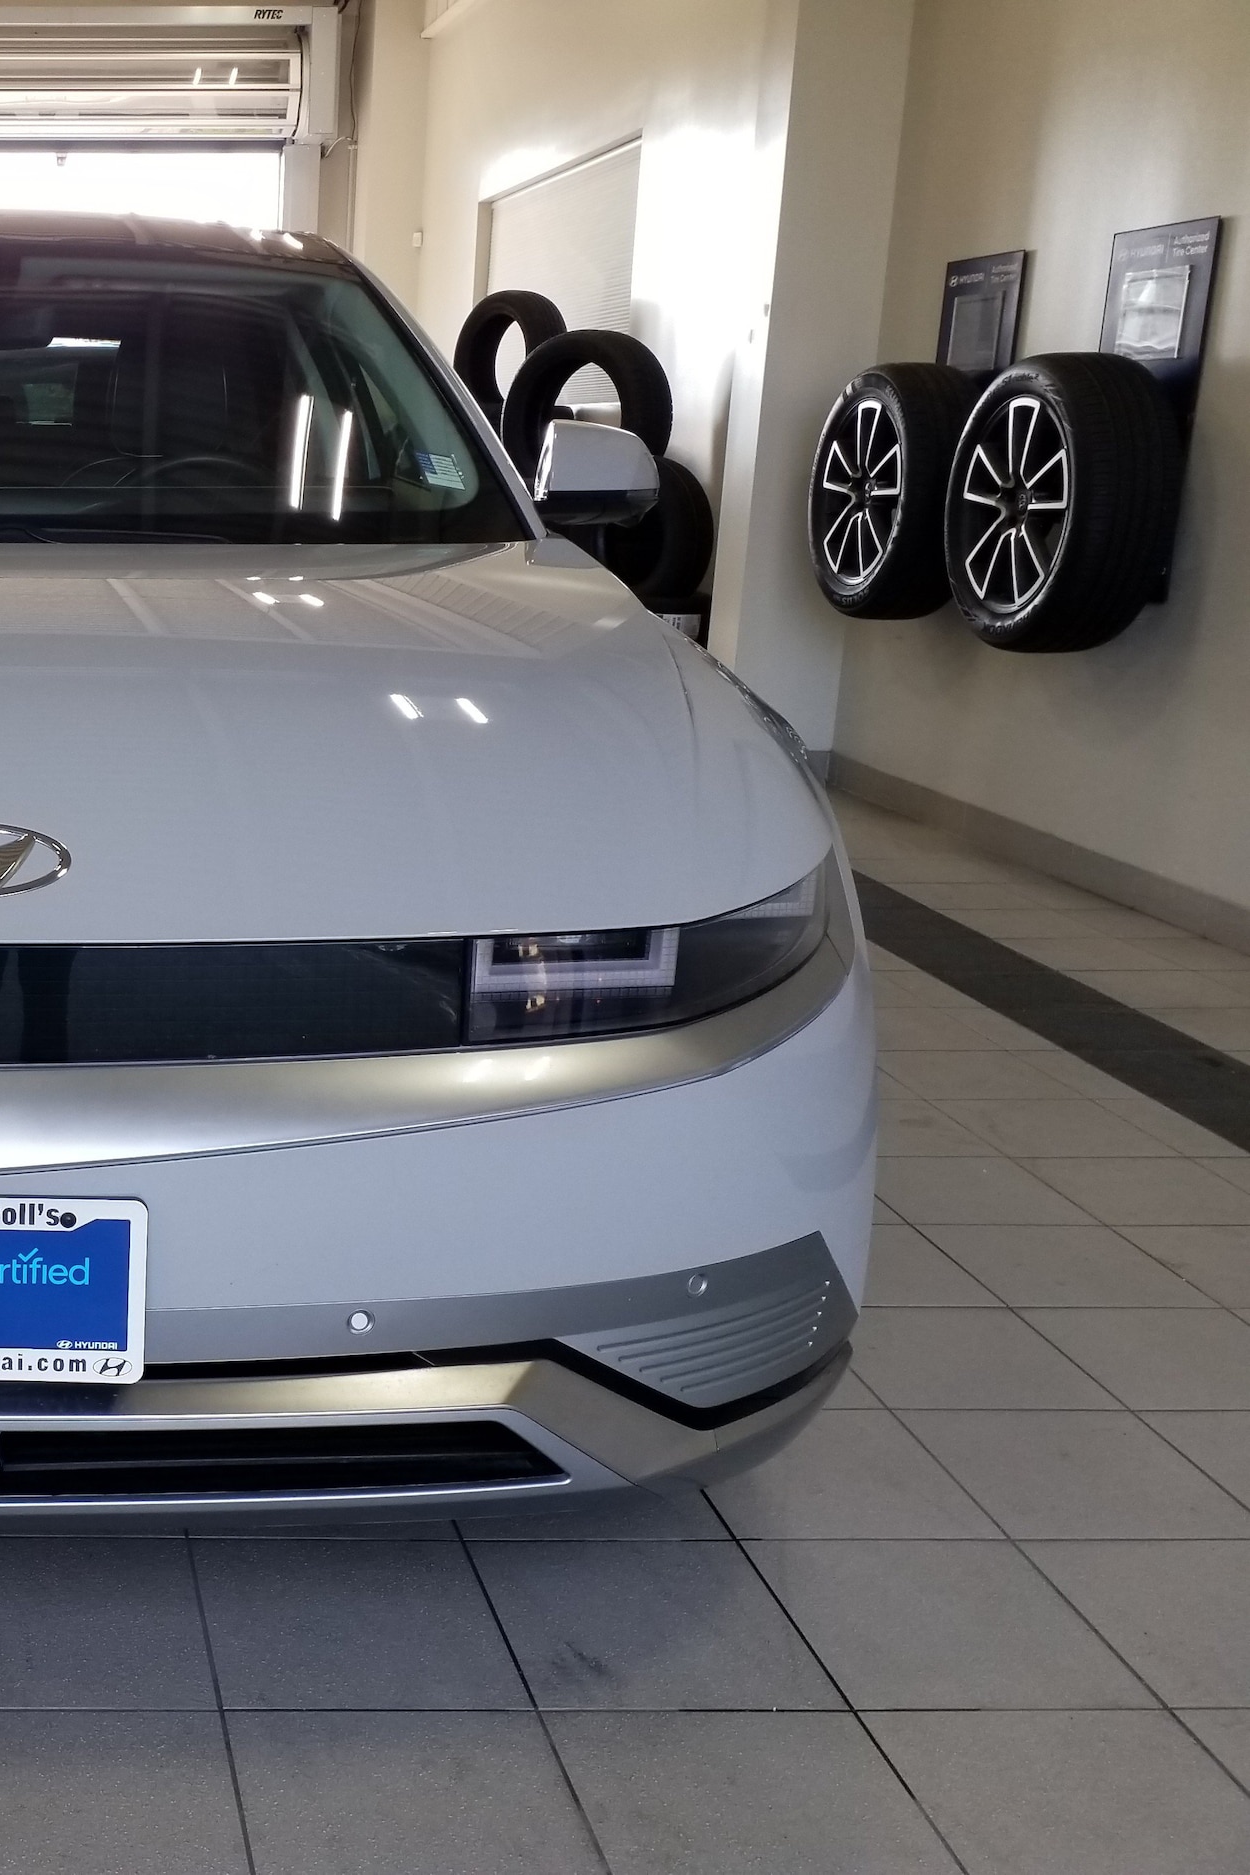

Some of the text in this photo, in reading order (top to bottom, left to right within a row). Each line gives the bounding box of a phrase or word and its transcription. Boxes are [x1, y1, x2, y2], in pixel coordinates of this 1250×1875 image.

[253, 9, 284, 19] RYTEC
[1173, 245, 1209, 257] Tire Center
[74, 1341, 118, 1350] HYUNDAI
